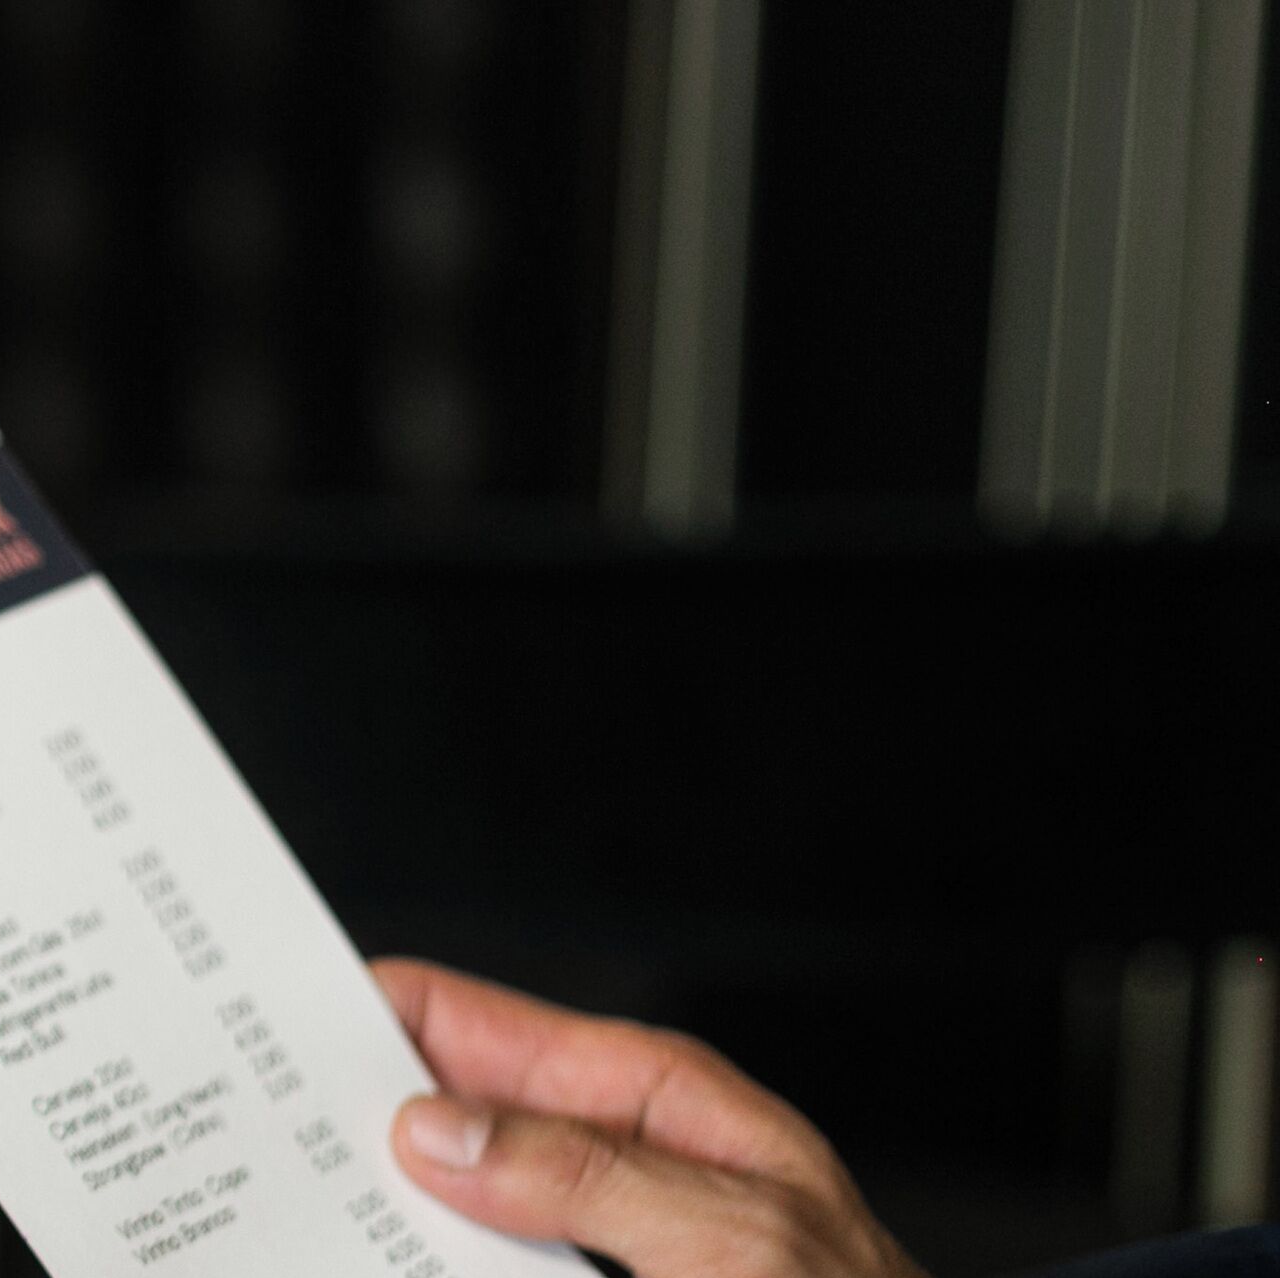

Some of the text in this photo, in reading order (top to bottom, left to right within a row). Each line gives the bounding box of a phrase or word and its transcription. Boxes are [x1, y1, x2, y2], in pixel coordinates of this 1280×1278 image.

[117, 1210, 165, 1239] Vinho
[160, 1189, 204, 1216] Tinto
[134, 1207, 236, 1265] Vinho Branco
